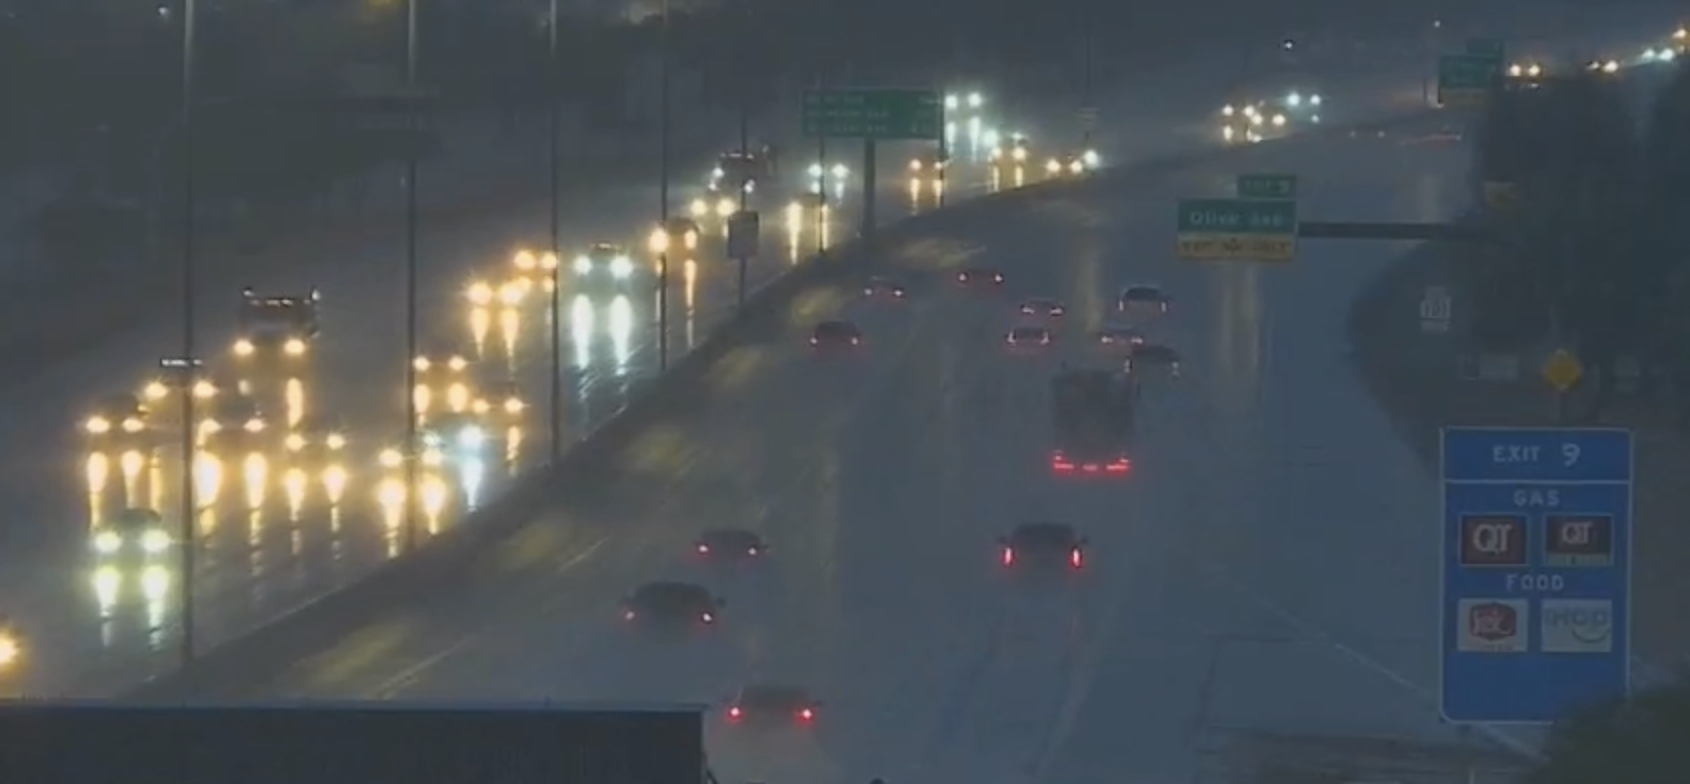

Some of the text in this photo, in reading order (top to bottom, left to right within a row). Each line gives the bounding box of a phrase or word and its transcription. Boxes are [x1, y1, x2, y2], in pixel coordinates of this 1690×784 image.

[1190, 211, 1242, 226] Olive
[1492, 443, 1581, 466] EXIT 9
[1513, 489, 1560, 507] GAS
[1473, 523, 1512, 554] QT
[1561, 521, 1592, 544] QT
[1505, 574, 1565, 592] FOOD
